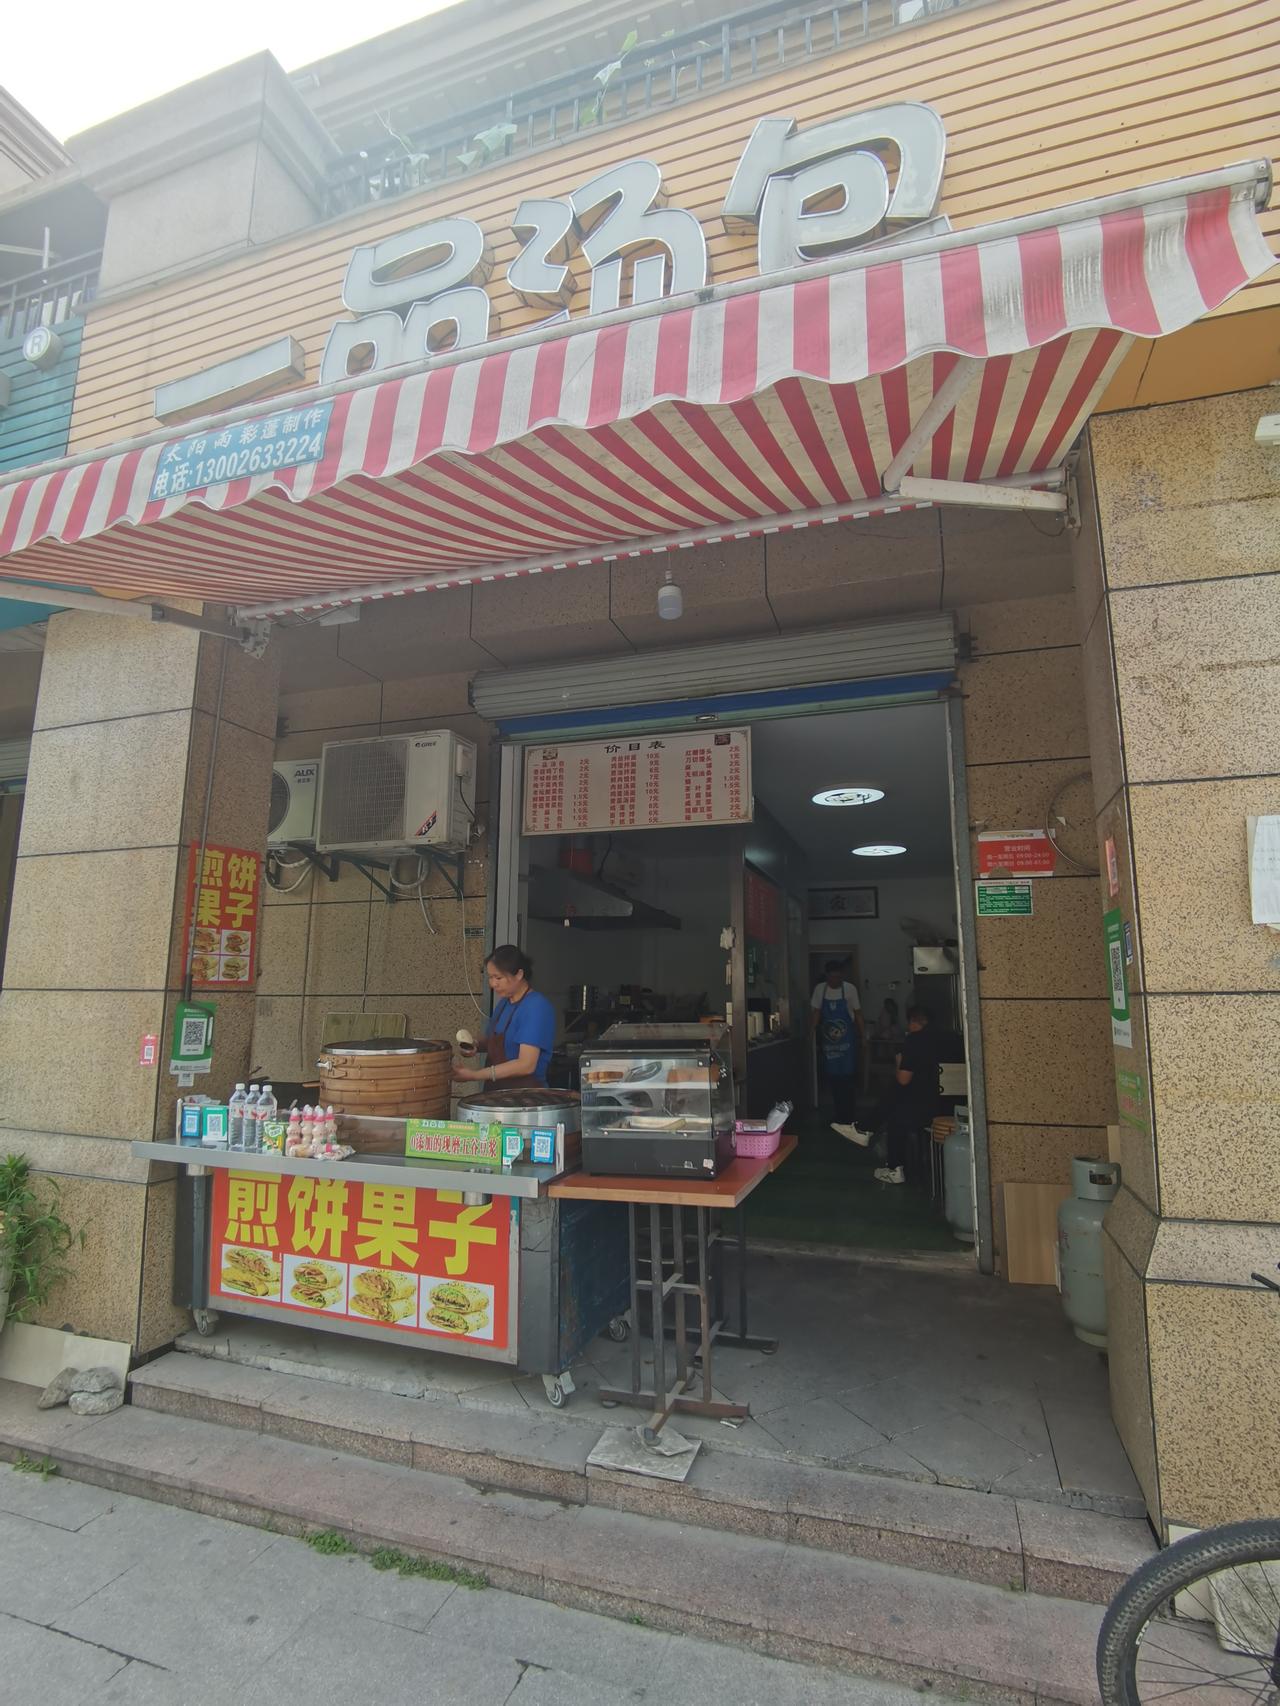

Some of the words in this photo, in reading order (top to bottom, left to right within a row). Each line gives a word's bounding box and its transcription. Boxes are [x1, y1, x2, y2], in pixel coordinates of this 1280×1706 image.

[154, 100, 947, 418] 一品汤包
[604, 739, 666, 754] 价目表
[294, 769, 314, 778] AUX
[193, 847, 258, 892] 煎饼
[190, 888, 255, 930] 果子
[224, 1167, 498, 1275] 煎饼果子
